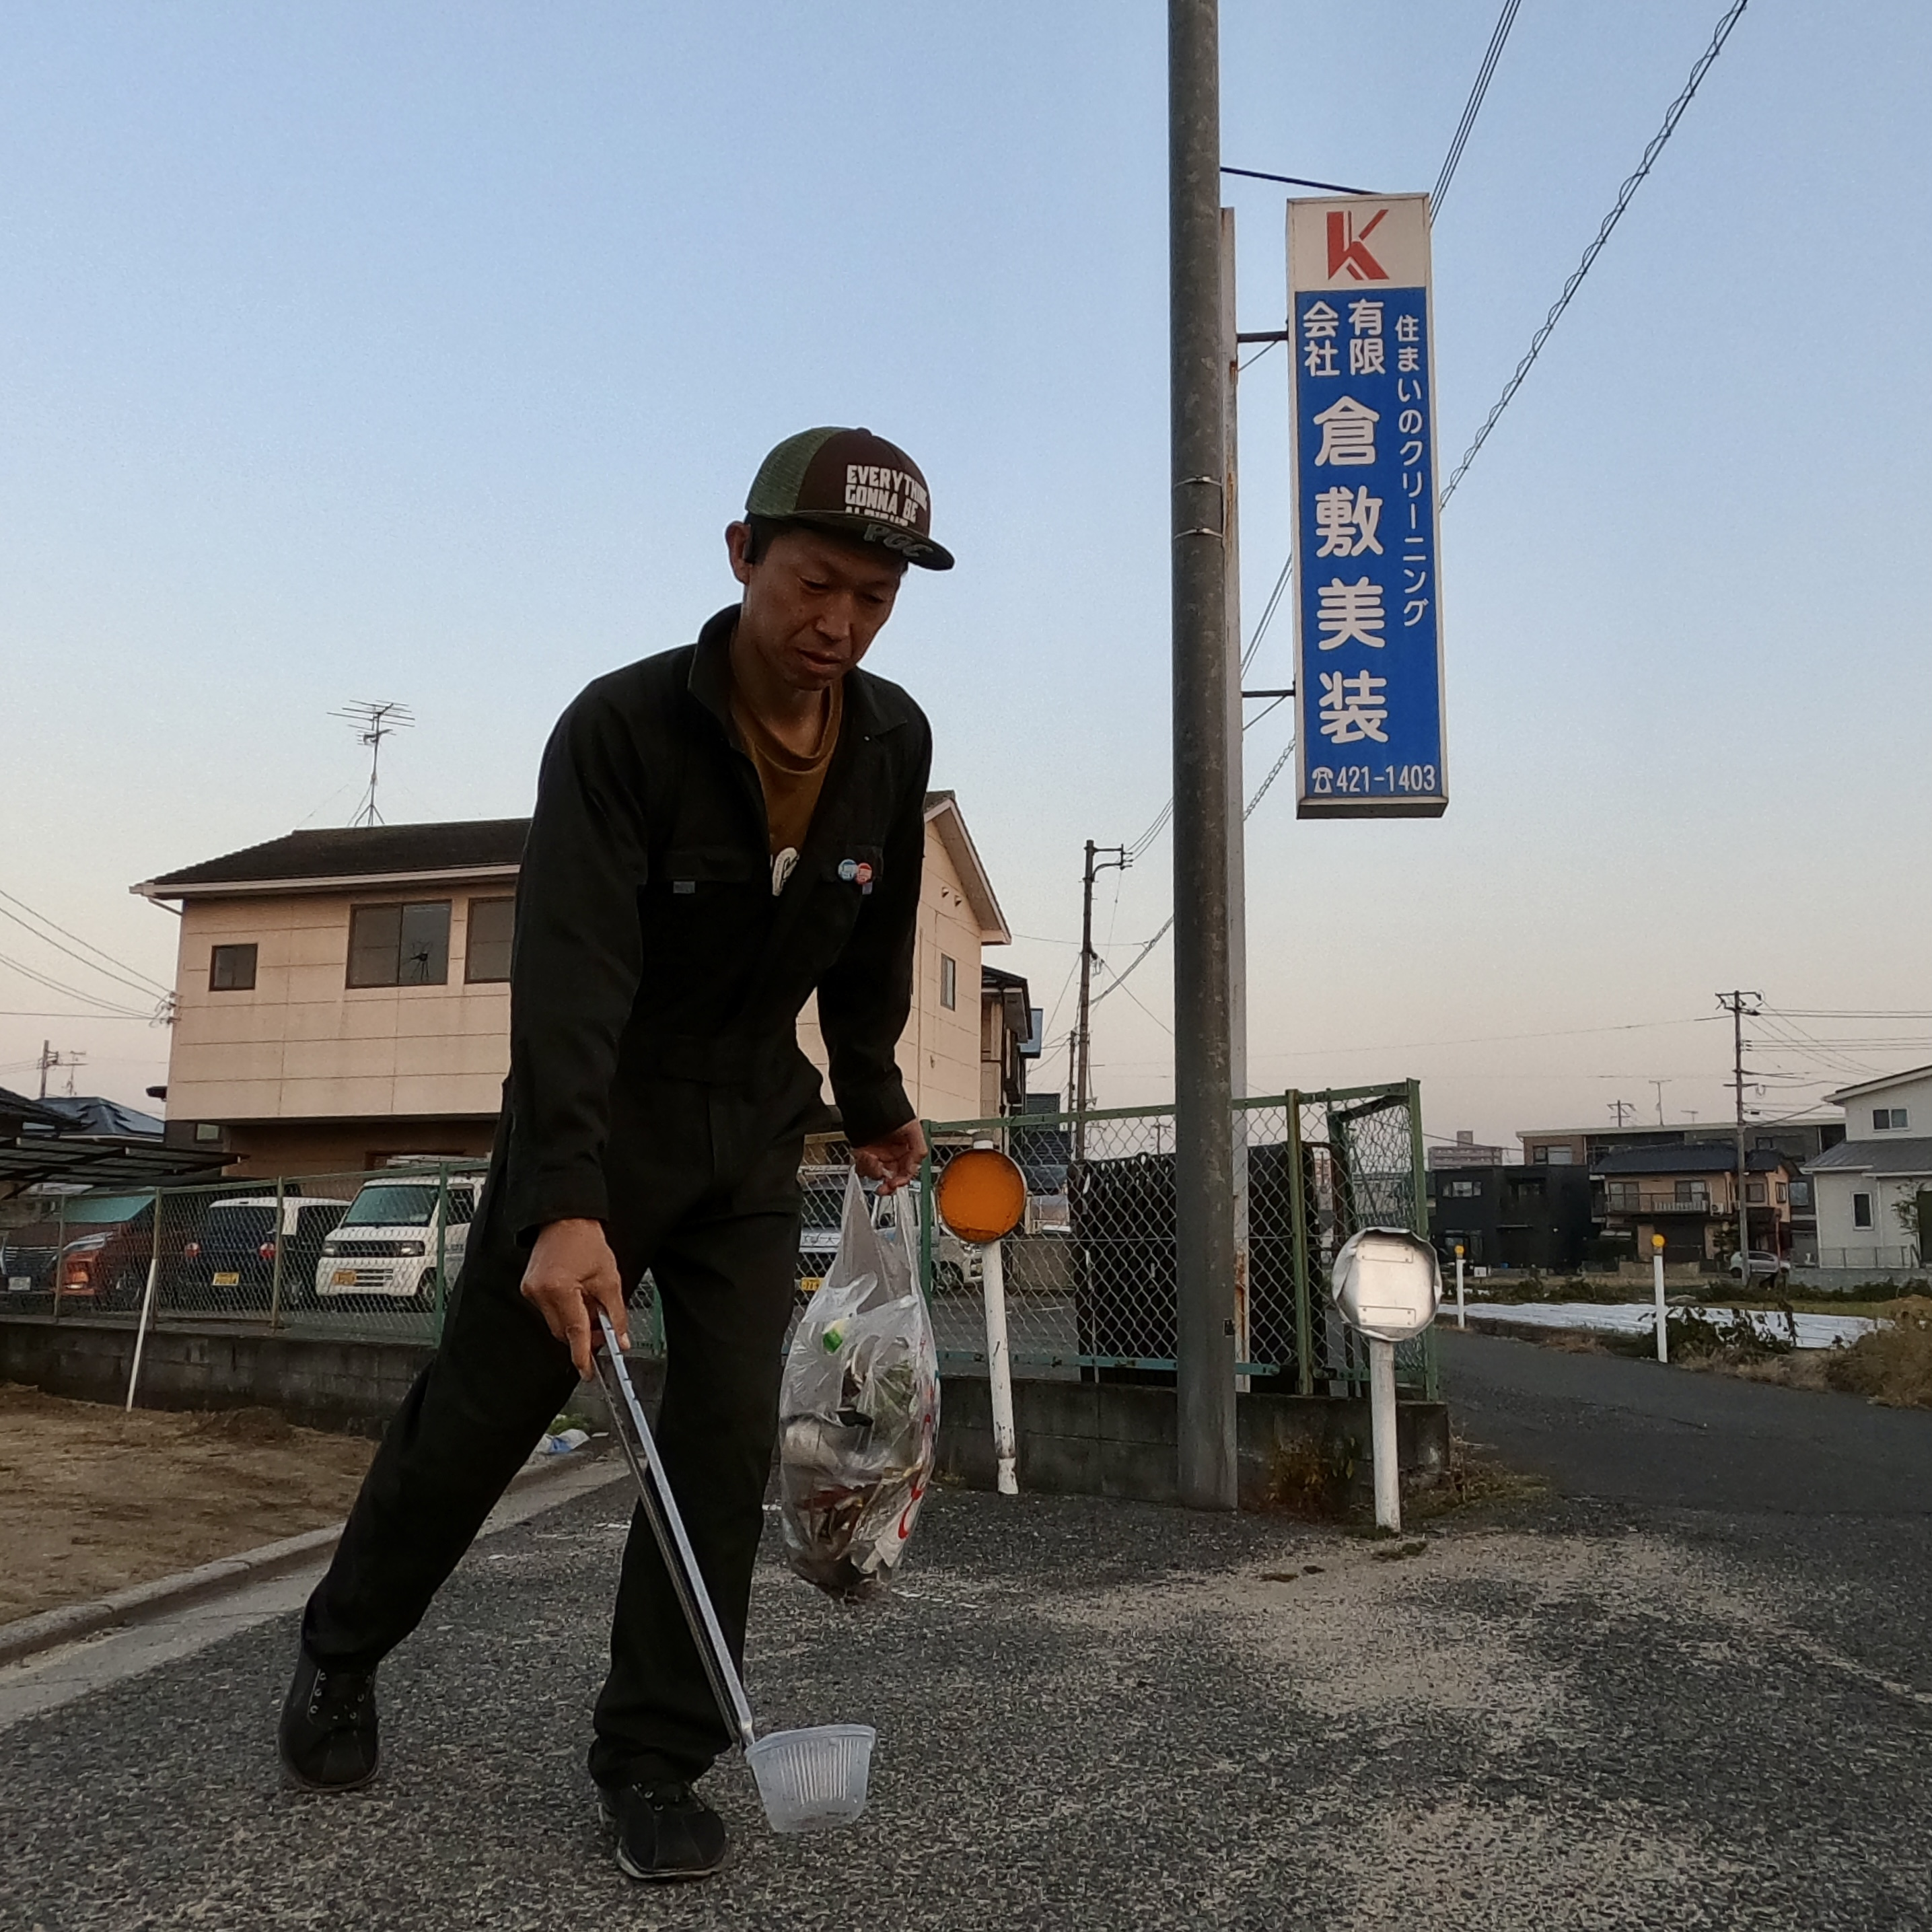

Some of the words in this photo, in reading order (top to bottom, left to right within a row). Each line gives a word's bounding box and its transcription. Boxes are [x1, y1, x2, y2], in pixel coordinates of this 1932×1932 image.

[1326, 209, 1389, 280] K
[845, 485, 898, 515] GONNA
[902, 497, 919, 524] BE
[1395, 314, 1429, 627] 住まいのクリーニング
[1313, 396, 1388, 744] 倉敷美装
[1336, 764, 1435, 793] 421-1403
